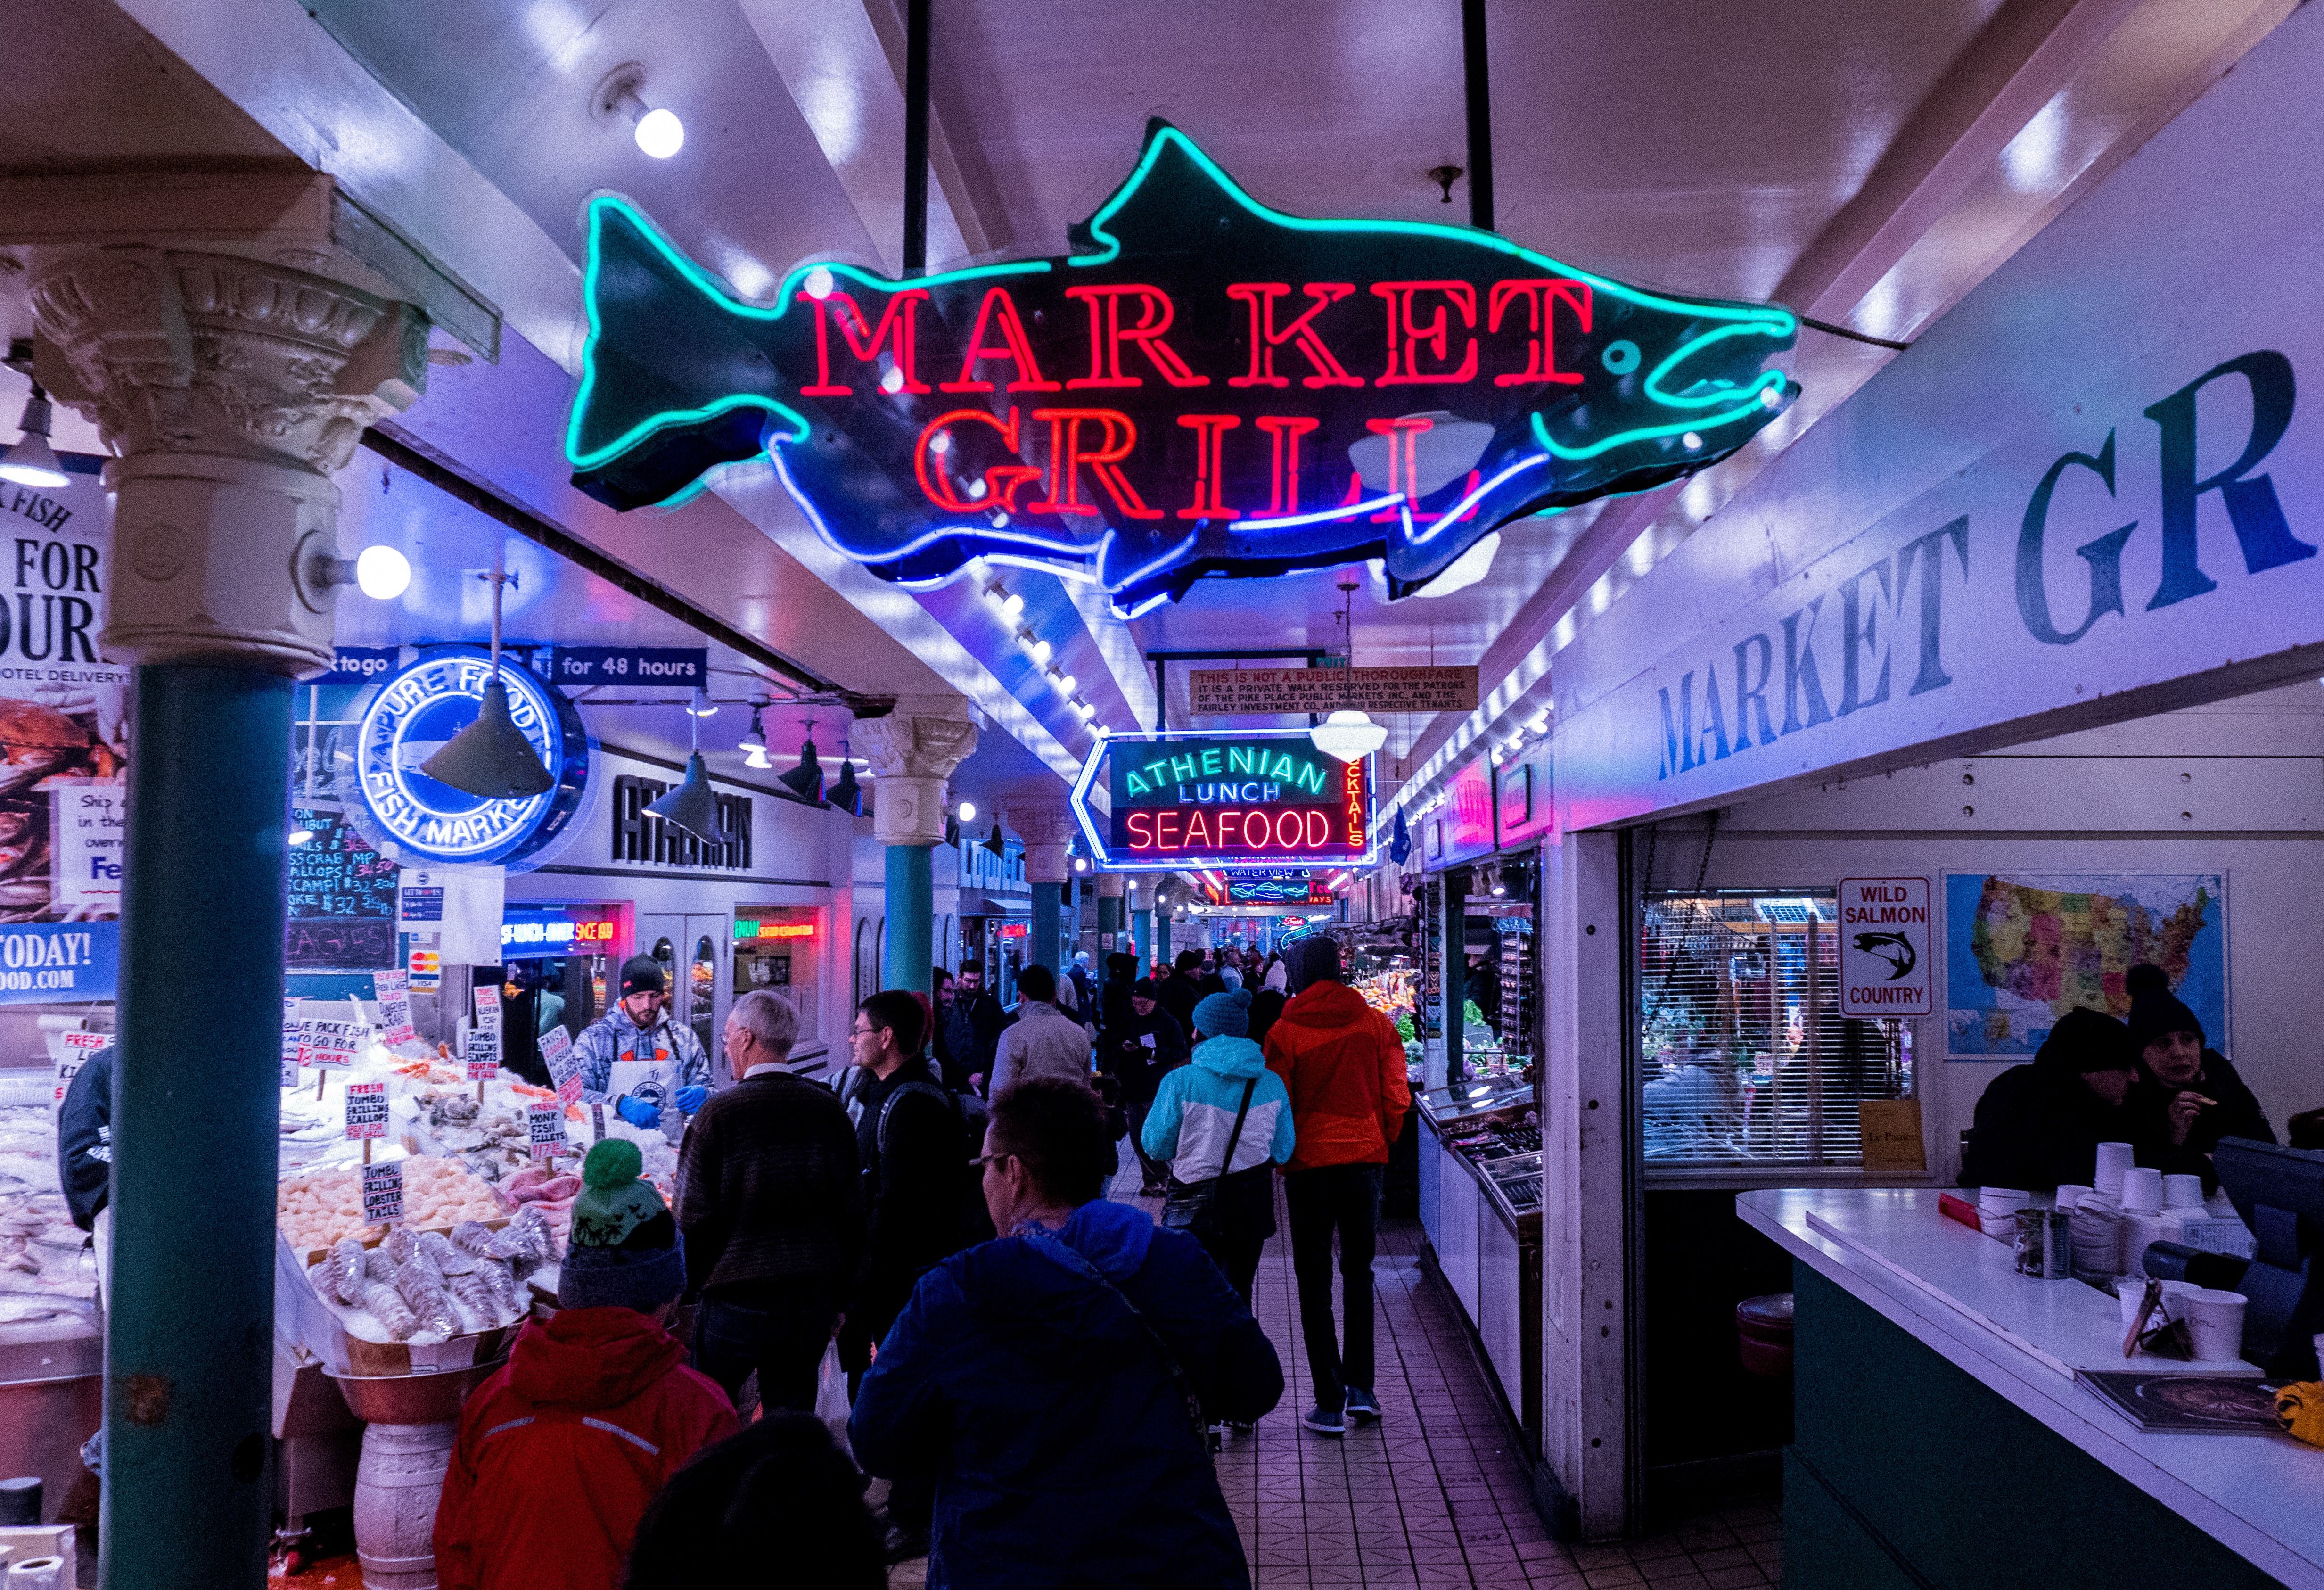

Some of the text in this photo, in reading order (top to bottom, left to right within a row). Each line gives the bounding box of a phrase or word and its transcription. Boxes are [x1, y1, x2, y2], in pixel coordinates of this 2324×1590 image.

[796, 278, 1593, 395] MARKET
[914, 406, 1481, 523] GRILL
[2015, 349, 2318, 646] GR
[11, 487, 73, 533] FISH
[15, 538, 101, 593] FOR
[1656, 514, 1971, 782] MARKET
[342, 655, 362, 670] to
[363, 659, 387, 676] go
[562, 657, 696, 676] for 48 hours
[49, 670, 124, 683] DELIVERY
[1199, 669, 1462, 684] THIS IS NOT A PUBLIC THOROUGHFARE
[383, 667, 446, 721] PURE
[1239, 684, 1282, 692] PRIVATE
[1288, 684, 1315, 692] WALK
[1321, 683, 1380, 691] RESERVED
[1424, 681, 1465, 690] PATRONS
[1199, 694, 1210, 702] OF
[1215, 694, 1234, 702] THE
[1238, 693, 1259, 701] PIKE
[1264, 693, 1296, 701] PLACE
[1299, 692, 1333, 700] PUBLIC
[1338, 692, 1384, 700] MARKETS
[1198, 703, 1237, 712] FAIRLEY
[1241, 702, 1300, 711] INVESTMENT
[1368, 700, 1419, 708] RESPECTIVE
[1421, 700, 1462, 708] TENANTS
[1126, 747, 1327, 799] ATHENIAN
[1179, 781, 1280, 803] LUNCH
[81, 795, 112, 814] Ship
[367, 772, 419, 836] FISH
[78, 816, 92, 827] in
[1127, 811, 1329, 849] SEAFOOD
[306, 852, 343, 865] CRAB
[353, 852, 376, 865] MP
[1231, 868, 1294, 876] WATER VIEW
[288, 879, 339, 892] CAMPI
[1860, 886, 1907, 903] WILD
[1845, 906, 1926, 923] SALMON
[1849, 987, 1923, 1004] COUNTRY
[315, 1022, 341, 1034] PACK
[65, 1034, 105, 1048] FRESH
[313, 1036, 329, 1046] GO
[334, 1038, 356, 1050] FOR
[469, 1031, 496, 1041] JUMBO
[315, 1053, 350, 1064] HOURS
[350, 1083, 384, 1095] FRESH
[347, 1094, 384, 1105] JUMBO
[346, 1113, 389, 1125] SCALLOPS
[529, 1112, 557, 1124] MONK
[531, 1122, 555, 1134] FISH
[531, 1131, 565, 1143] FILLETS
[364, 1191, 402, 1209] LOBSTER
[368, 1204, 400, 1220] TAILS
